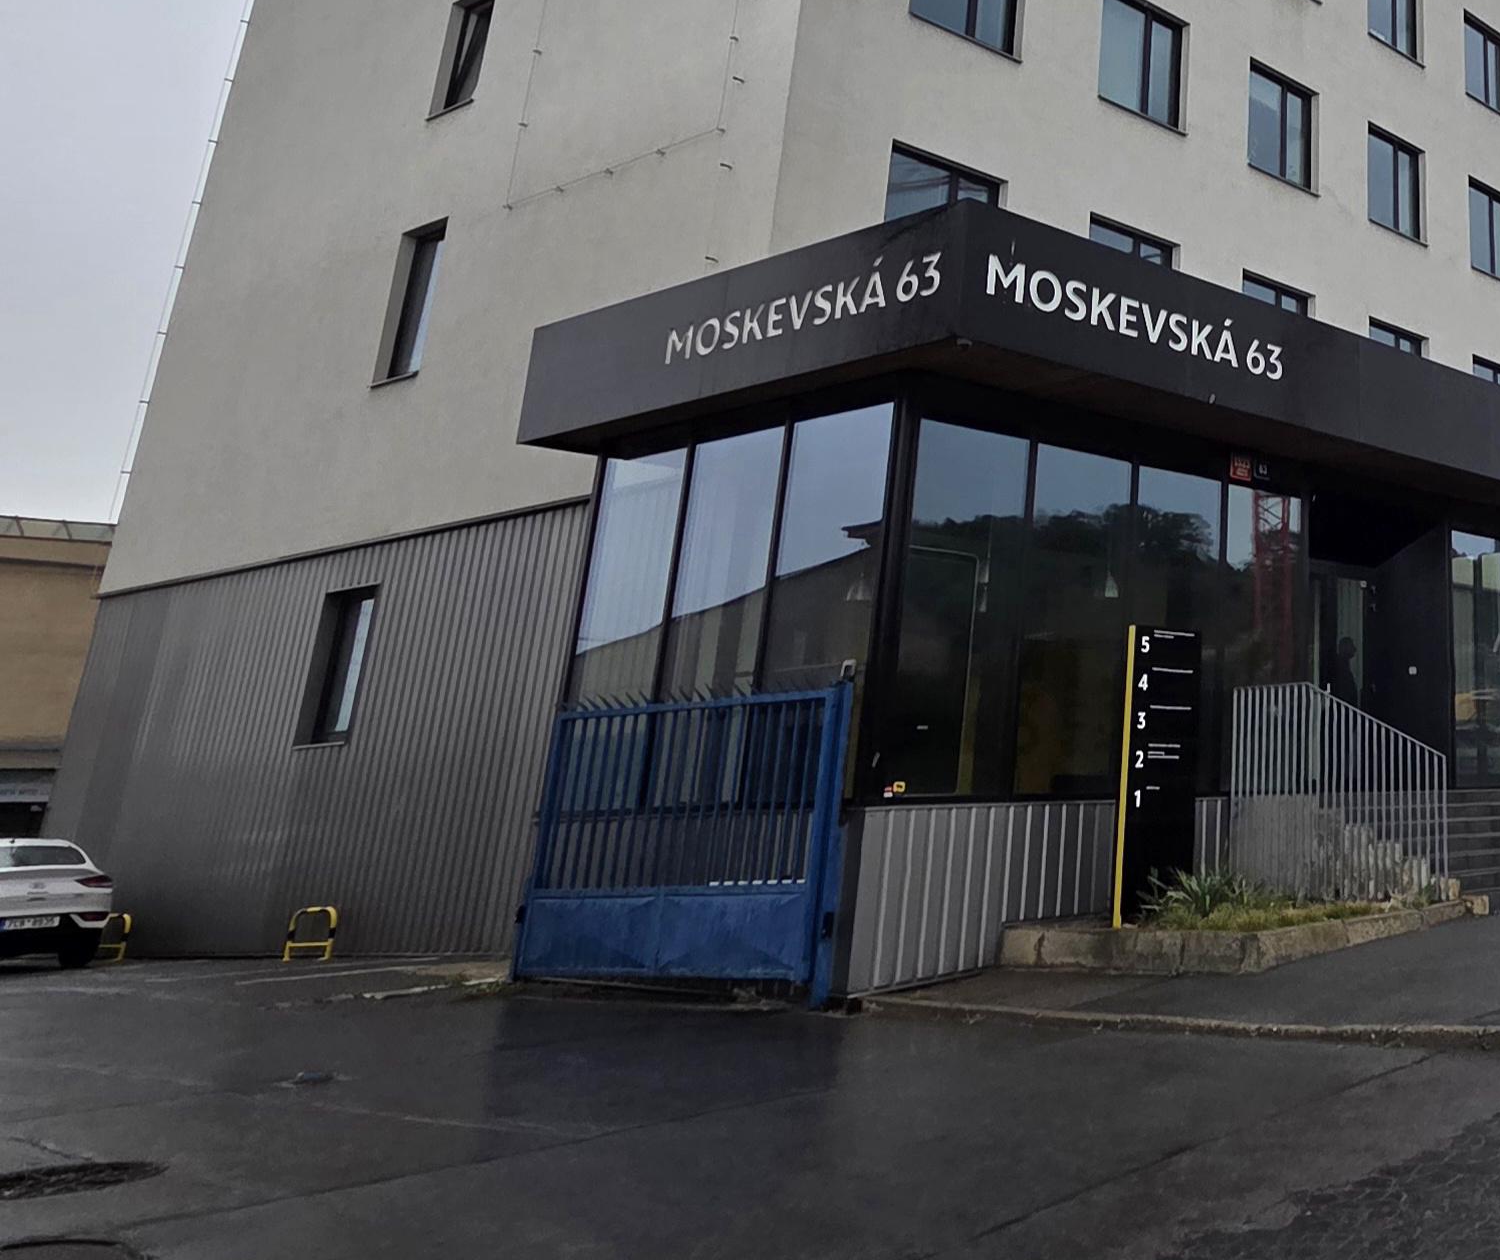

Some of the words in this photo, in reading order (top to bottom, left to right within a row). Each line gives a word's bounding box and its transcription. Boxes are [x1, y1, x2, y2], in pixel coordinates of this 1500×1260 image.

[664, 255, 886, 365] MOSKEVSKÁ
[896, 251, 942, 303] 63
[986, 253, 1239, 368] MOSKEVSKÁ
[1246, 339, 1284, 380] 63
[1140, 635, 1151, 653] 5
[1137, 673, 1149, 691] 4
[1136, 711, 1147, 729] 3
[1134, 750, 1145, 768] 2
[1133, 789, 1142, 808] 1
